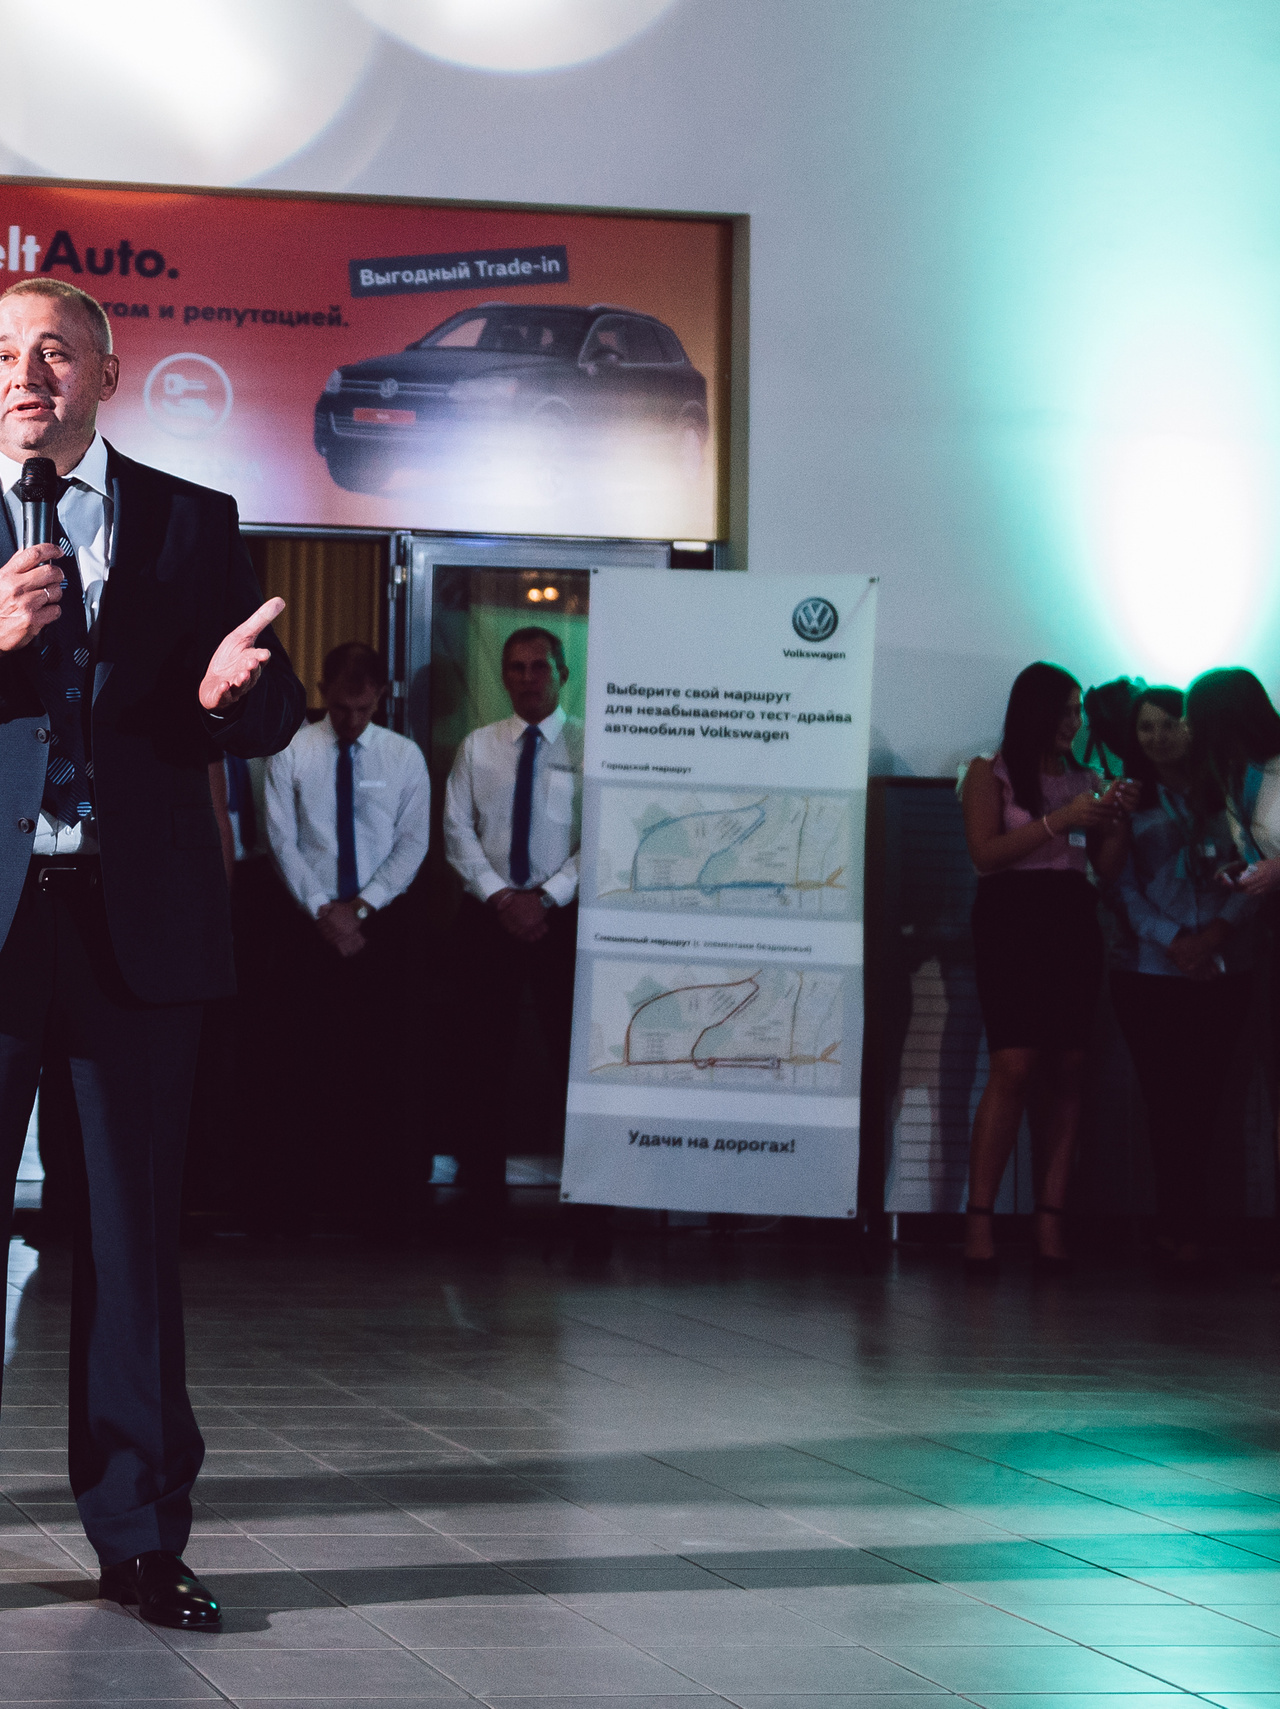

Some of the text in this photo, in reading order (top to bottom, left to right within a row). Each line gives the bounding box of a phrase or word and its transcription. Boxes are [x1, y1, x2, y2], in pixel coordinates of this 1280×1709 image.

[359, 256, 561, 287] Выгодный Trade-in
[158, 304, 174, 320] и
[183, 304, 350, 328] репутацией.
[783, 648, 846, 661] Volkswagen
[606, 682, 791, 704] Выберите свой маршрут
[605, 704, 852, 725] для незабываемого тест-драйва
[604, 722, 790, 742] автомобиля Volkswagen
[628, 1130, 796, 1155] Удачи на дорогах!
